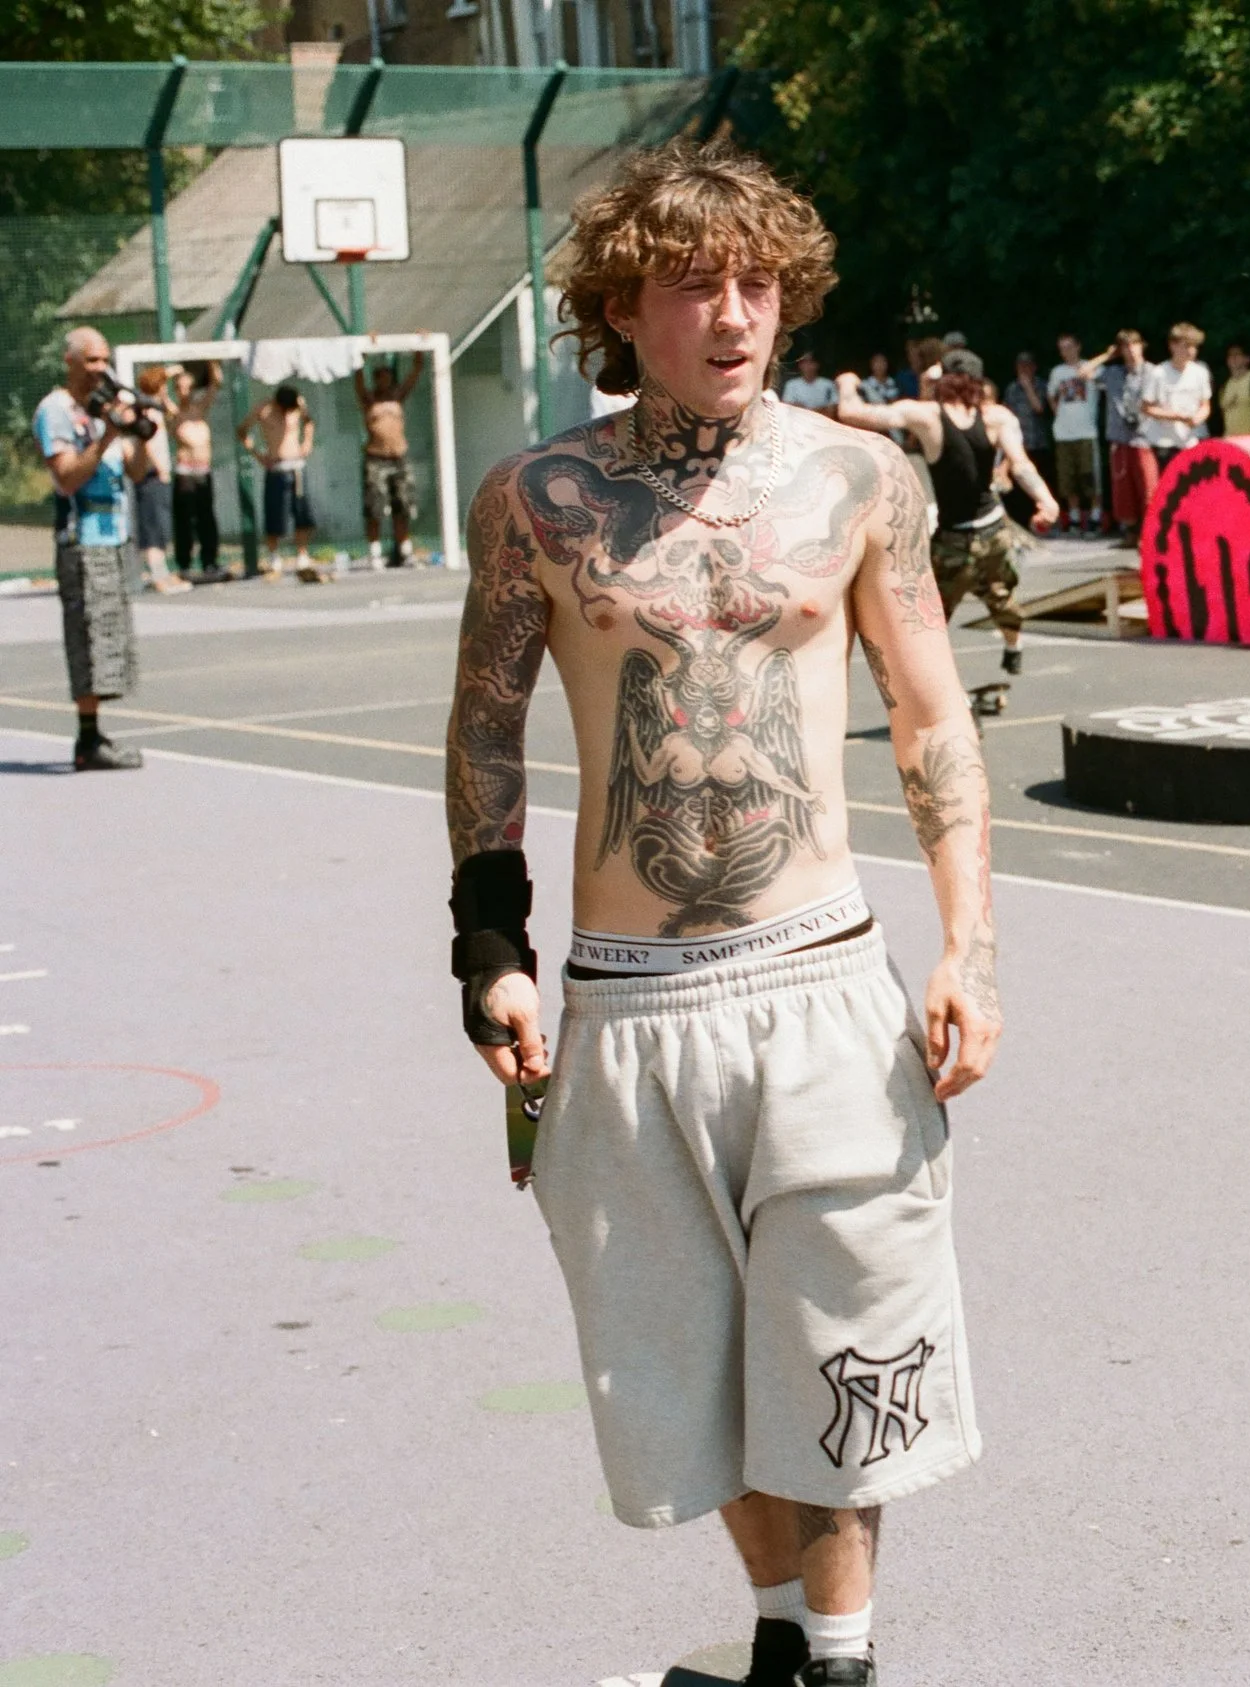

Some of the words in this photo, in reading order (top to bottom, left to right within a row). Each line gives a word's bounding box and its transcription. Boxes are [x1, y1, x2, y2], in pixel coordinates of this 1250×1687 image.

[587, 945, 649, 964] WEEK?
[682, 942, 740, 964] SAME
[743, 926, 796, 952] TIME
[799, 905, 848, 936] NEXT
[819, 1336, 935, 1468] NY
